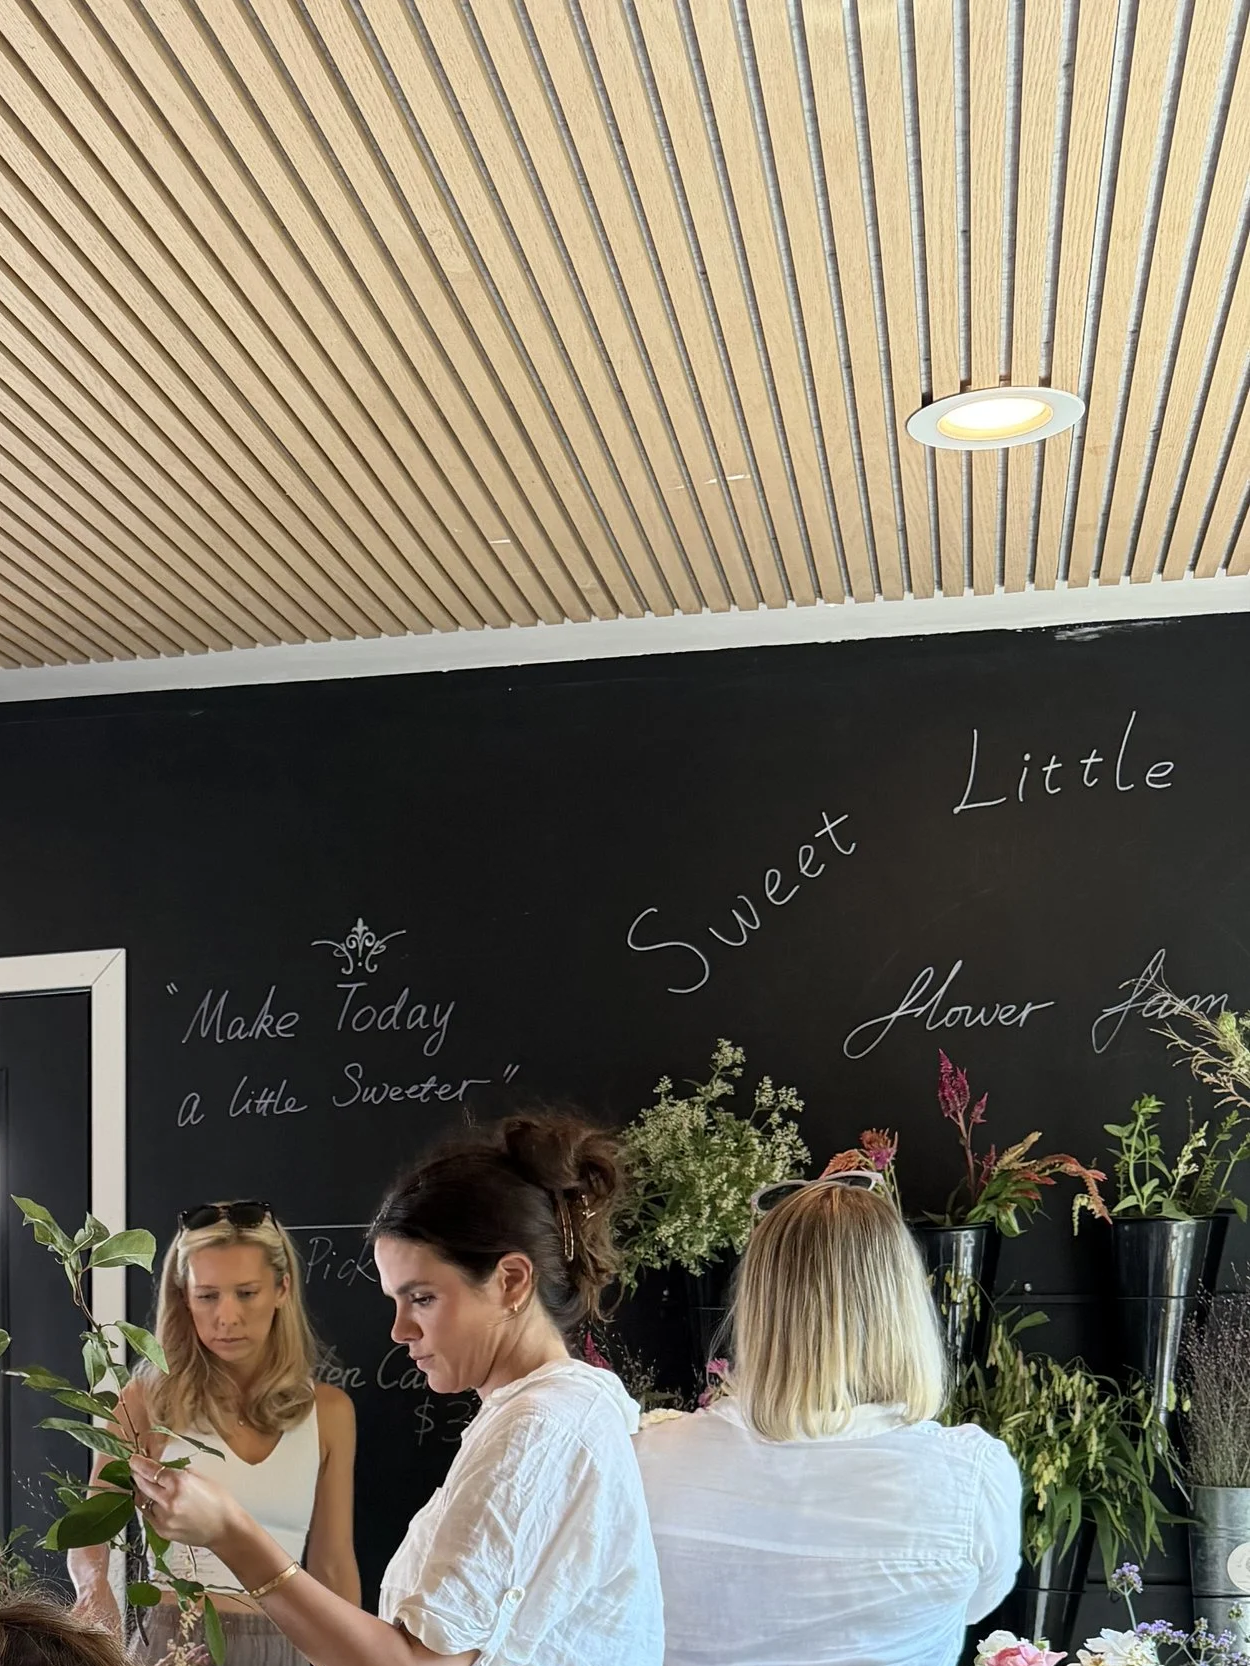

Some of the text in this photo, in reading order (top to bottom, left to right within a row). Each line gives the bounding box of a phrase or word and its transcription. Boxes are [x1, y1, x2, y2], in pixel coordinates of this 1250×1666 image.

[626, 710, 1174, 994] Sweet Little
[336, 982, 455, 1057] Today
[177, 1092, 205, 1127] a
